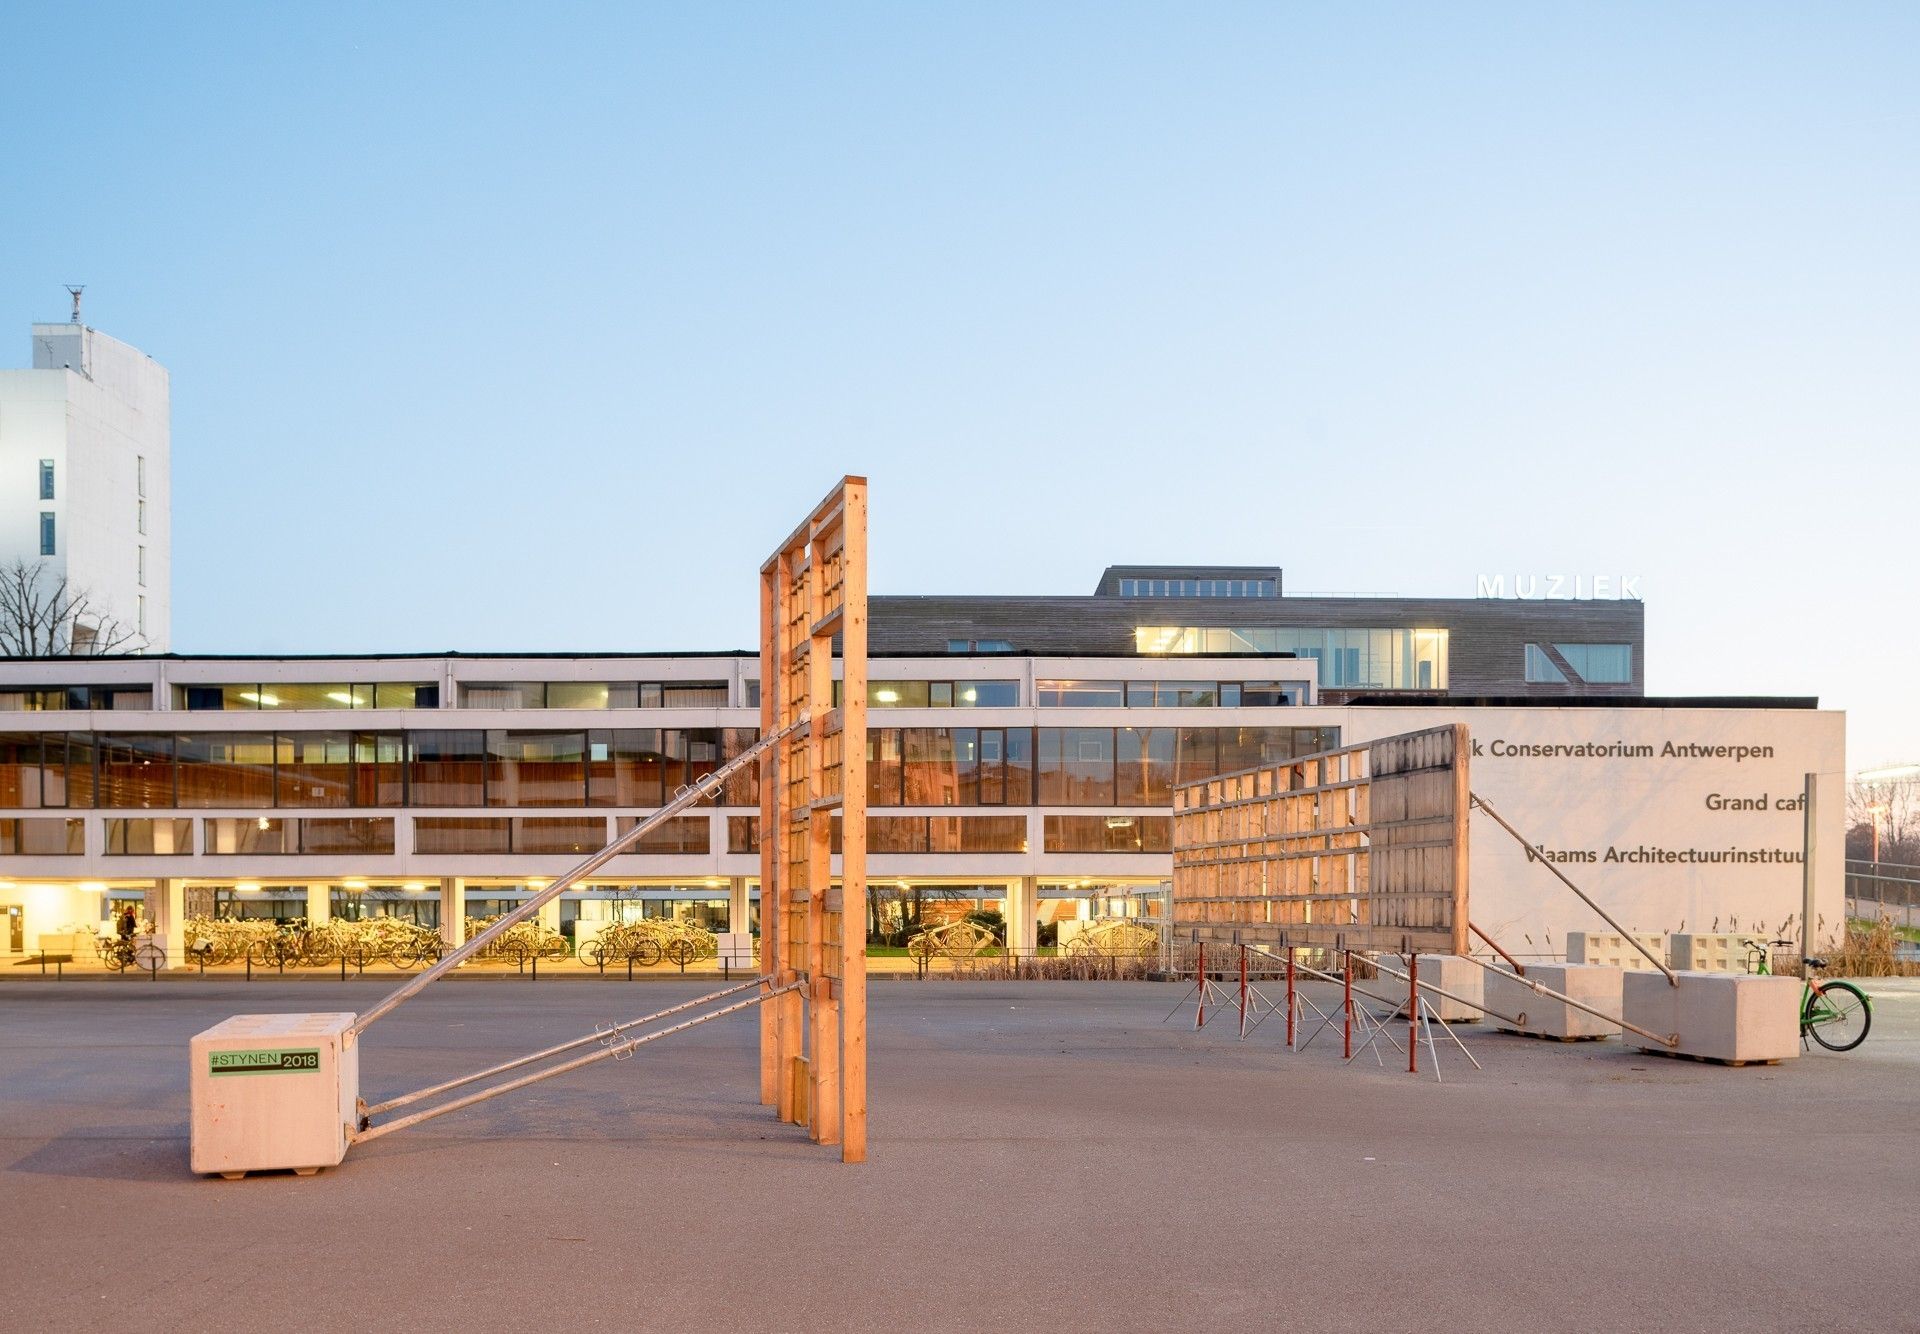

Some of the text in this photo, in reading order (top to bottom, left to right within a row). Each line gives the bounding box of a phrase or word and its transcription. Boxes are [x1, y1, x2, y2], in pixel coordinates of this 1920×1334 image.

[1477, 574, 1641, 600] MUZIEK
[1490, 740, 1654, 758] Conservatorium
[1660, 740, 1774, 763] Antwerpen
[1705, 793, 1806, 811] Grand caf
[1603, 846, 1805, 864] Architectuurinstituu
[212, 1053, 317, 1067] #STYNEN 2018
